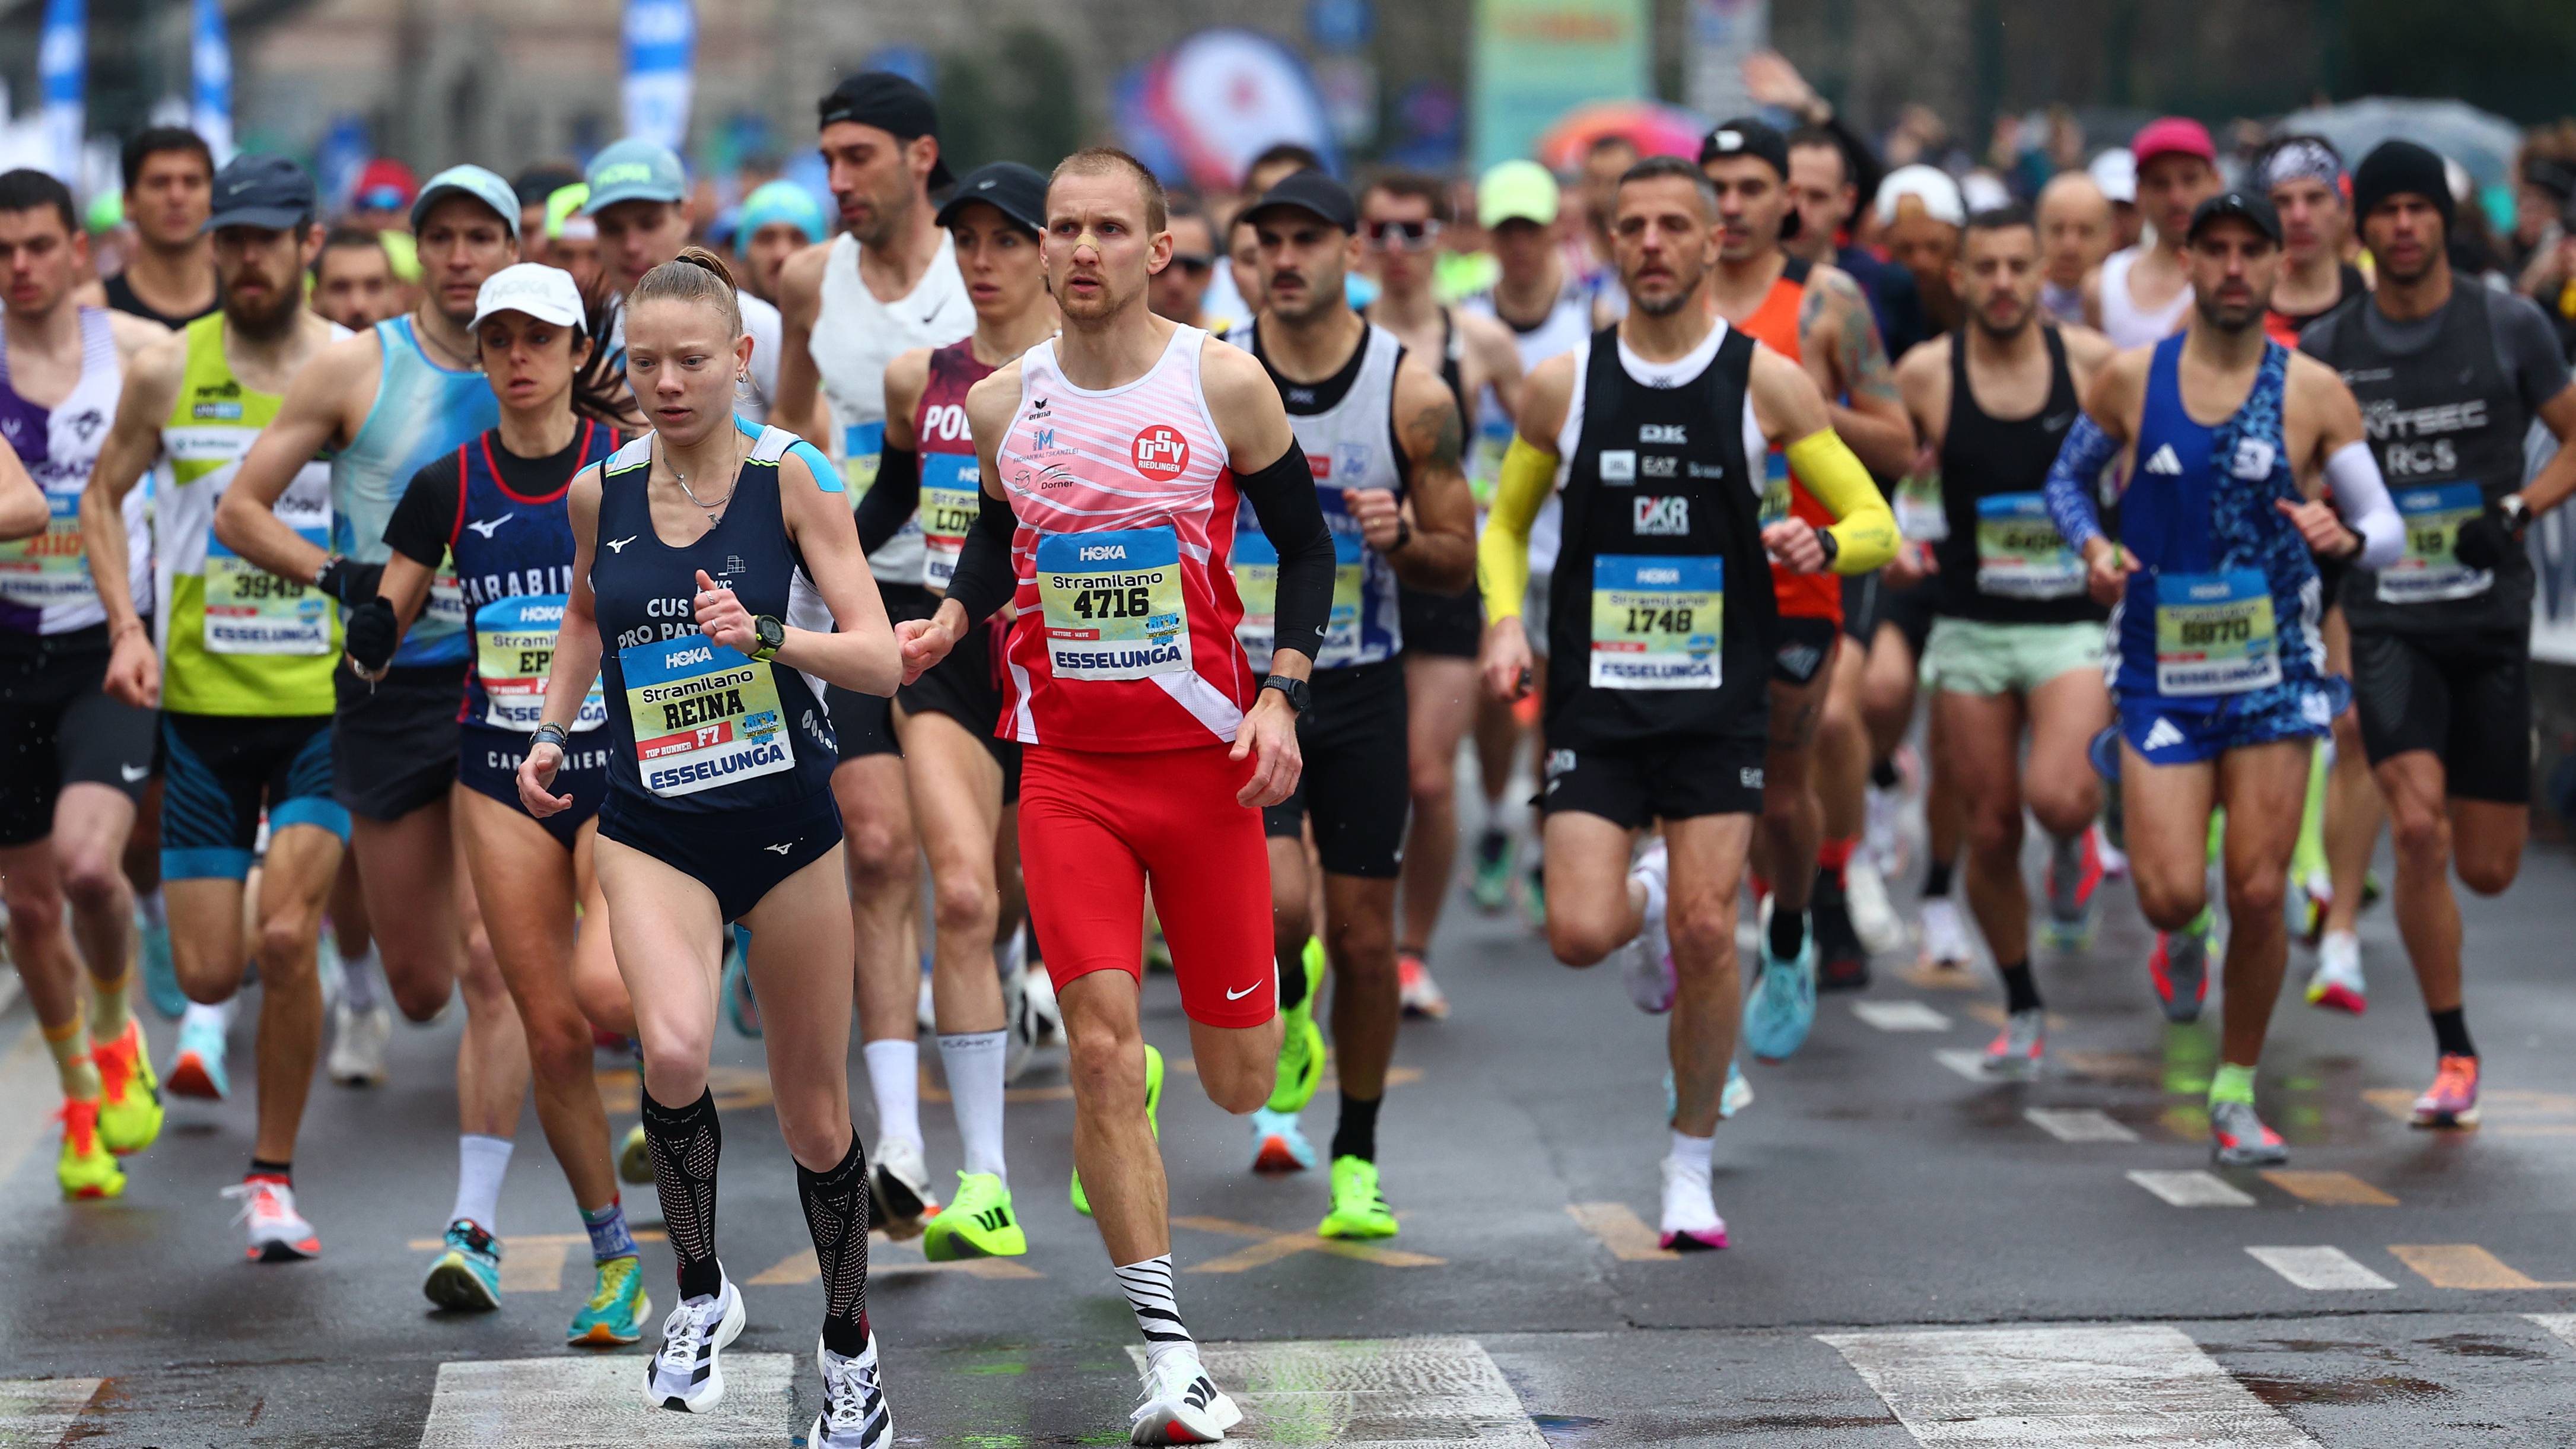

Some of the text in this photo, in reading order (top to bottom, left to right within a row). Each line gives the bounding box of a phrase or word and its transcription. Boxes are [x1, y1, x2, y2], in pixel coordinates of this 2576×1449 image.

[1028, 410, 1051, 421] erima
[1013, 447, 1079, 465] FACHANWALTSKANZLEI
[1138, 460, 1181, 473] RIEDLINGEN
[1041, 480, 1074, 490] Dorner
[1079, 545, 1127, 561] HOKA
[1052, 572, 1163, 589] Stramilano
[1636, 568, 1680, 584] HOKA
[647, 598, 689, 618] CUS
[1073, 587, 1149, 619] 4716
[1609, 593, 1710, 608] Stramilano
[520, 605, 566, 622] HOK
[1625, 608, 1693, 635] 1748
[617, 625, 653, 650] PRO
[520, 650, 554, 673] EP
[665, 646, 713, 670] HOKA
[1055, 645, 1182, 669] ESSELUNGA
[1600, 663, 1713, 679] ESSELUNGA
[643, 670, 754, 704] Stramilano
[663, 688, 745, 730] REINA
[645, 724, 720, 758] TOP RUNNER F7
[650, 744, 785, 790] ESSELUNGA
